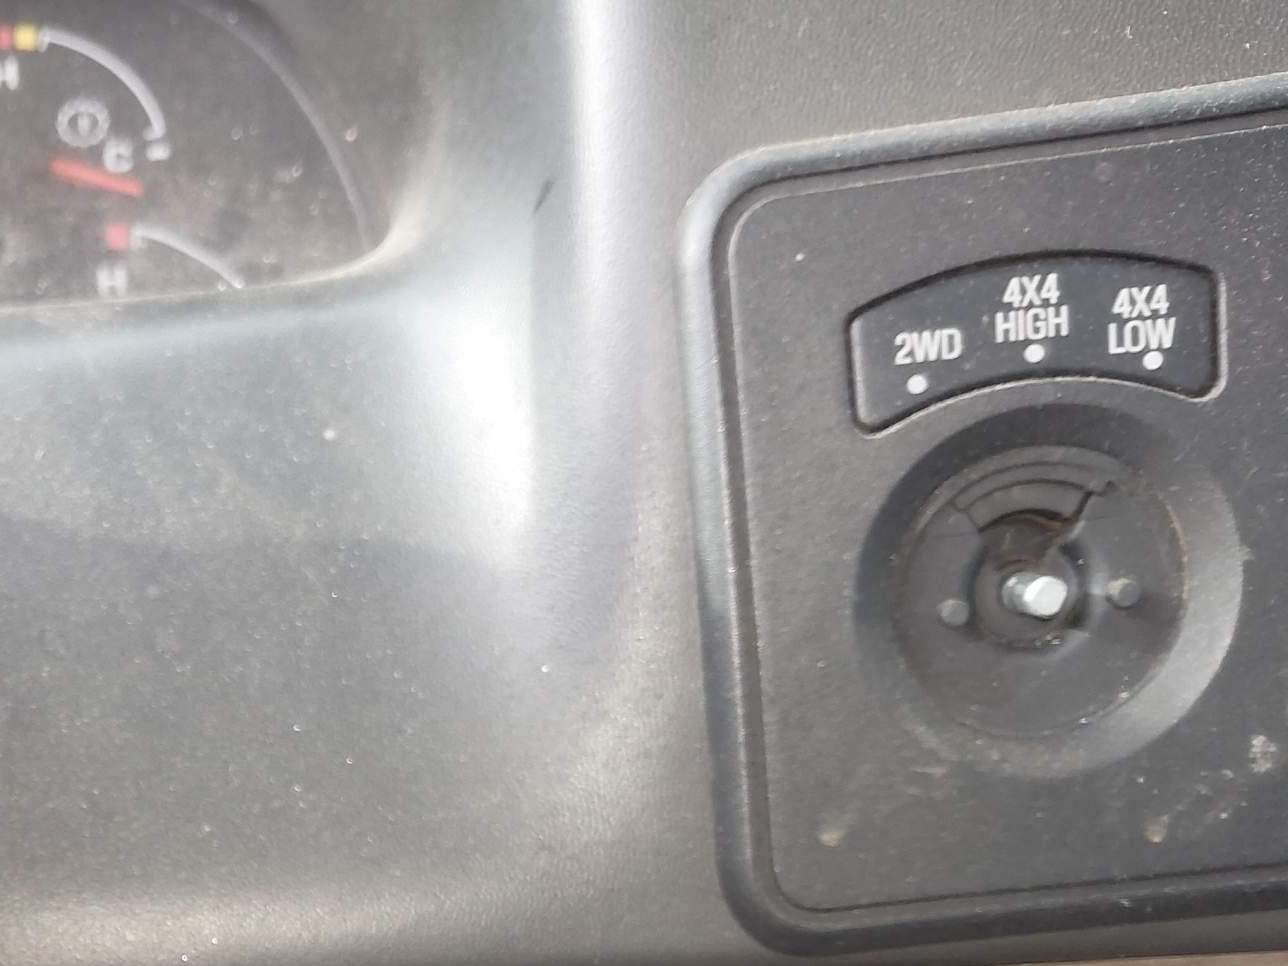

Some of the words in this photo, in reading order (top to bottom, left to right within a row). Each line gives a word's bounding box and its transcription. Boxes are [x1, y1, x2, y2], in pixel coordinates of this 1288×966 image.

[1002, 273, 1060, 308] 4X4
[1112, 284, 1170, 318] 4X4
[995, 306, 1069, 343] HIGH
[1108, 317, 1176, 354] LOW
[894, 328, 962, 365] 2WD
